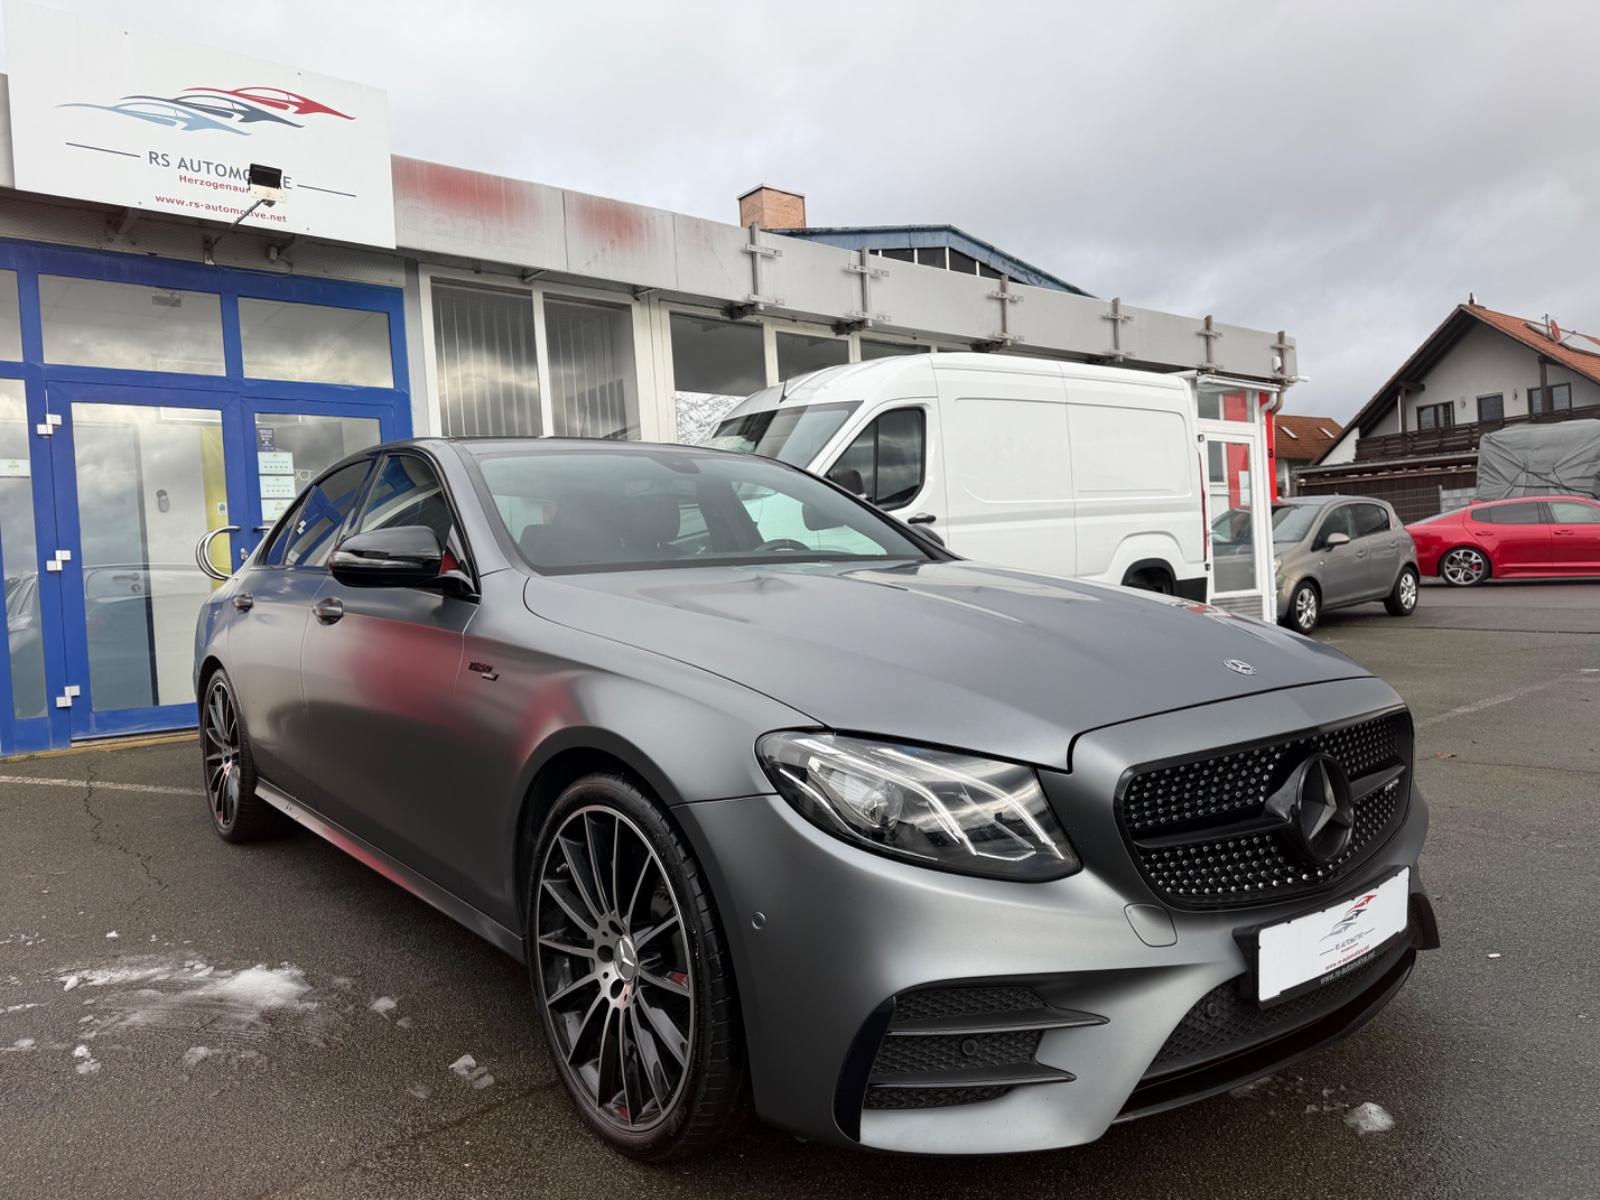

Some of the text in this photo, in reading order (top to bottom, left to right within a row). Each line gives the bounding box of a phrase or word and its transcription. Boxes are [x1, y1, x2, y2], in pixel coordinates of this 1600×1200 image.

[148, 151, 293, 190] RS AUTOMOE
[178, 174, 251, 194] Herzogenaur
[155, 195, 288, 223] www.rs-automoive.net
